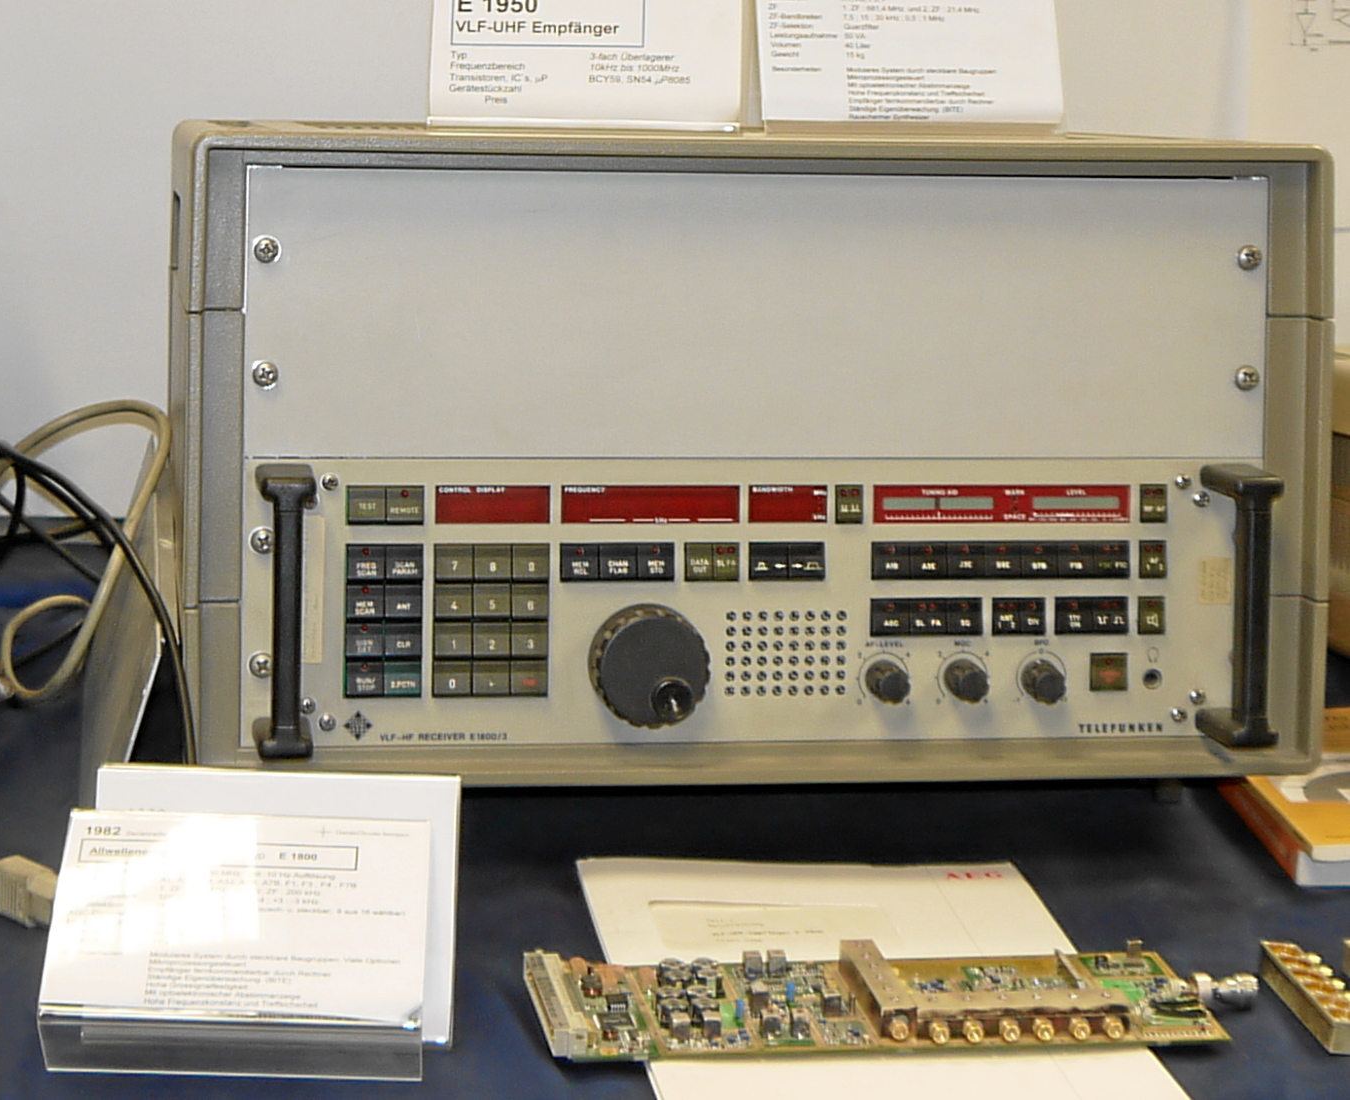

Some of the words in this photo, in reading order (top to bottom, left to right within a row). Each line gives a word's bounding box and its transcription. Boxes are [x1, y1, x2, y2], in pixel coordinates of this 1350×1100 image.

[485, 0, 538, 13] 1950
[455, 20, 526, 34] VLF-UHF
[531, 20, 620, 37] Empfänger
[451, 51, 467, 61] Typ
[589, 53, 618, 62] 3-fach
[621, 52, 675, 63] Überlagerer
[450, 62, 526, 72] Frequenzbereich
[590, 64, 618, 73] 10kHz
[620, 64, 635, 73] bis
[637, 64, 680, 73] 1000MHz
[449, 84, 522, 93] Gerätestückzahl
[484, 95, 508, 104] Preis
[358, 502, 376, 510] TEST
[390, 506, 419, 515] REMOTE
[1078, 723, 1164, 734] TELEFUNKEN
[379, 733, 415, 742] VLF-HF
[418, 733, 466, 741] RECEIVER
[85, 825, 122, 836] 1982
[291, 852, 318, 862] 1800
